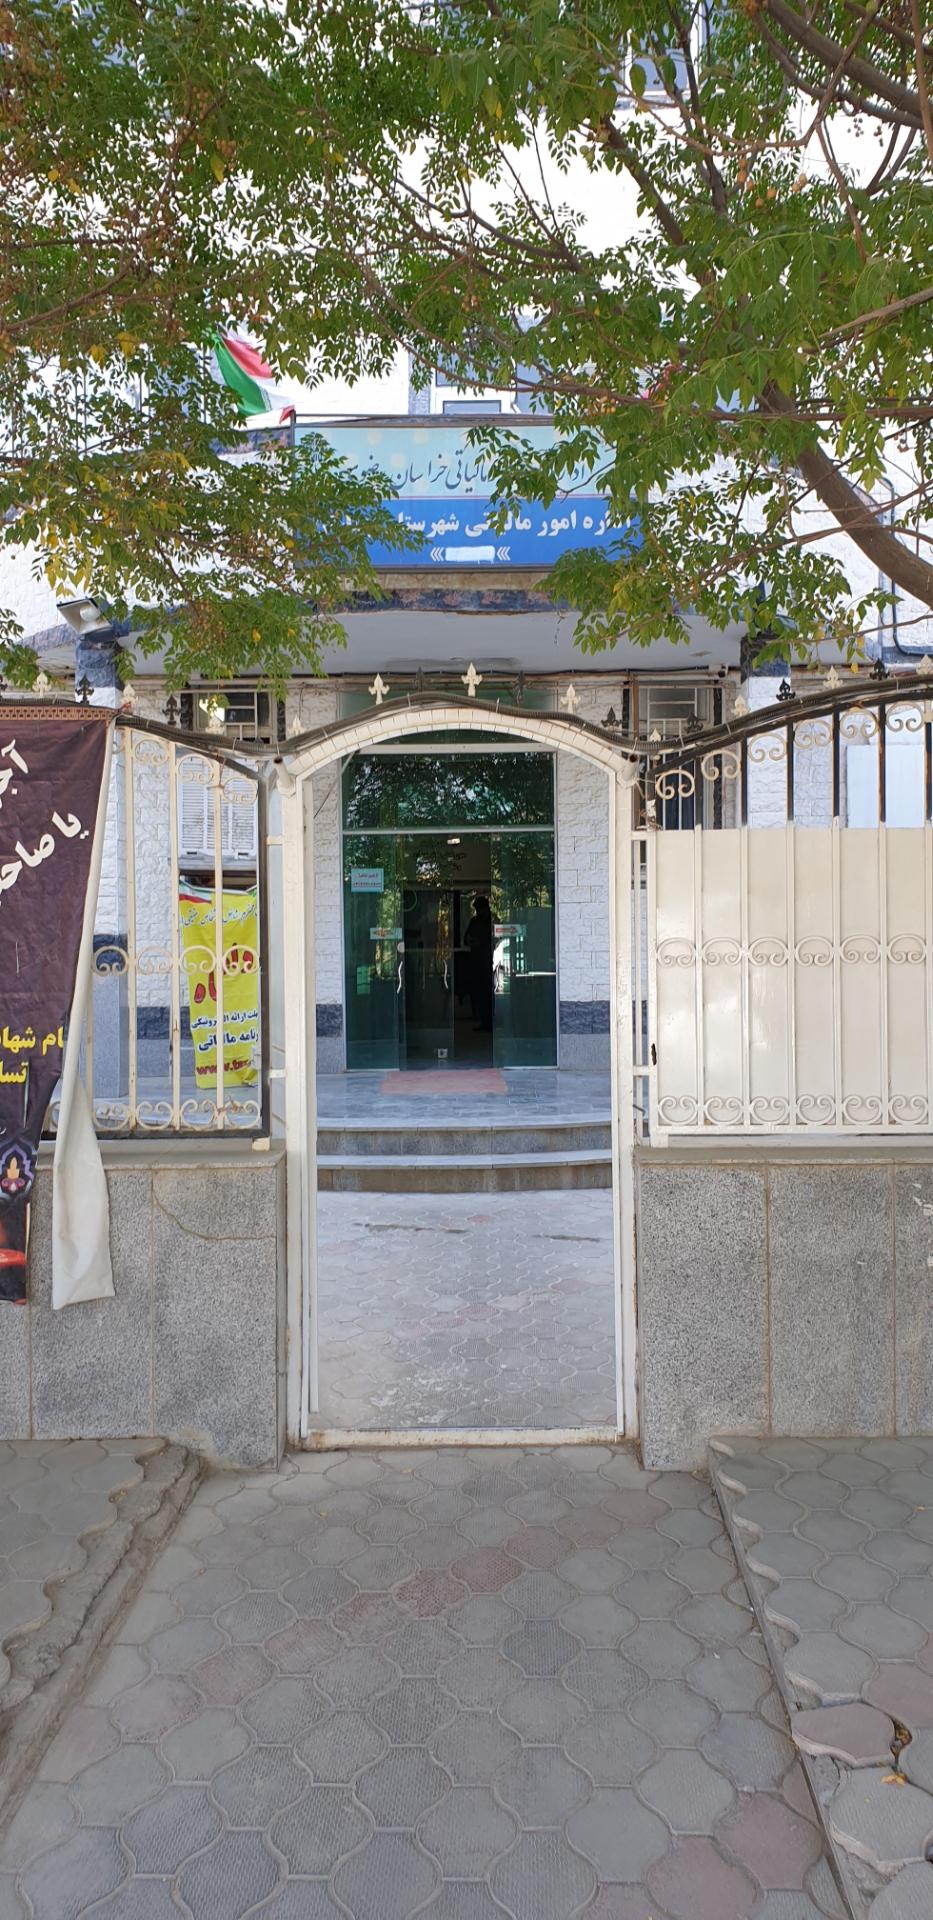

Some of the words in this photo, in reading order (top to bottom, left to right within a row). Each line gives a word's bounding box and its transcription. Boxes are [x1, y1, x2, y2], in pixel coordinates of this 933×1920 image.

[391, 453, 448, 491] خراسان
[397, 511, 460, 538] شهرستا
[537, 509, 577, 537] امور
[52, 811, 89, 840] یا
